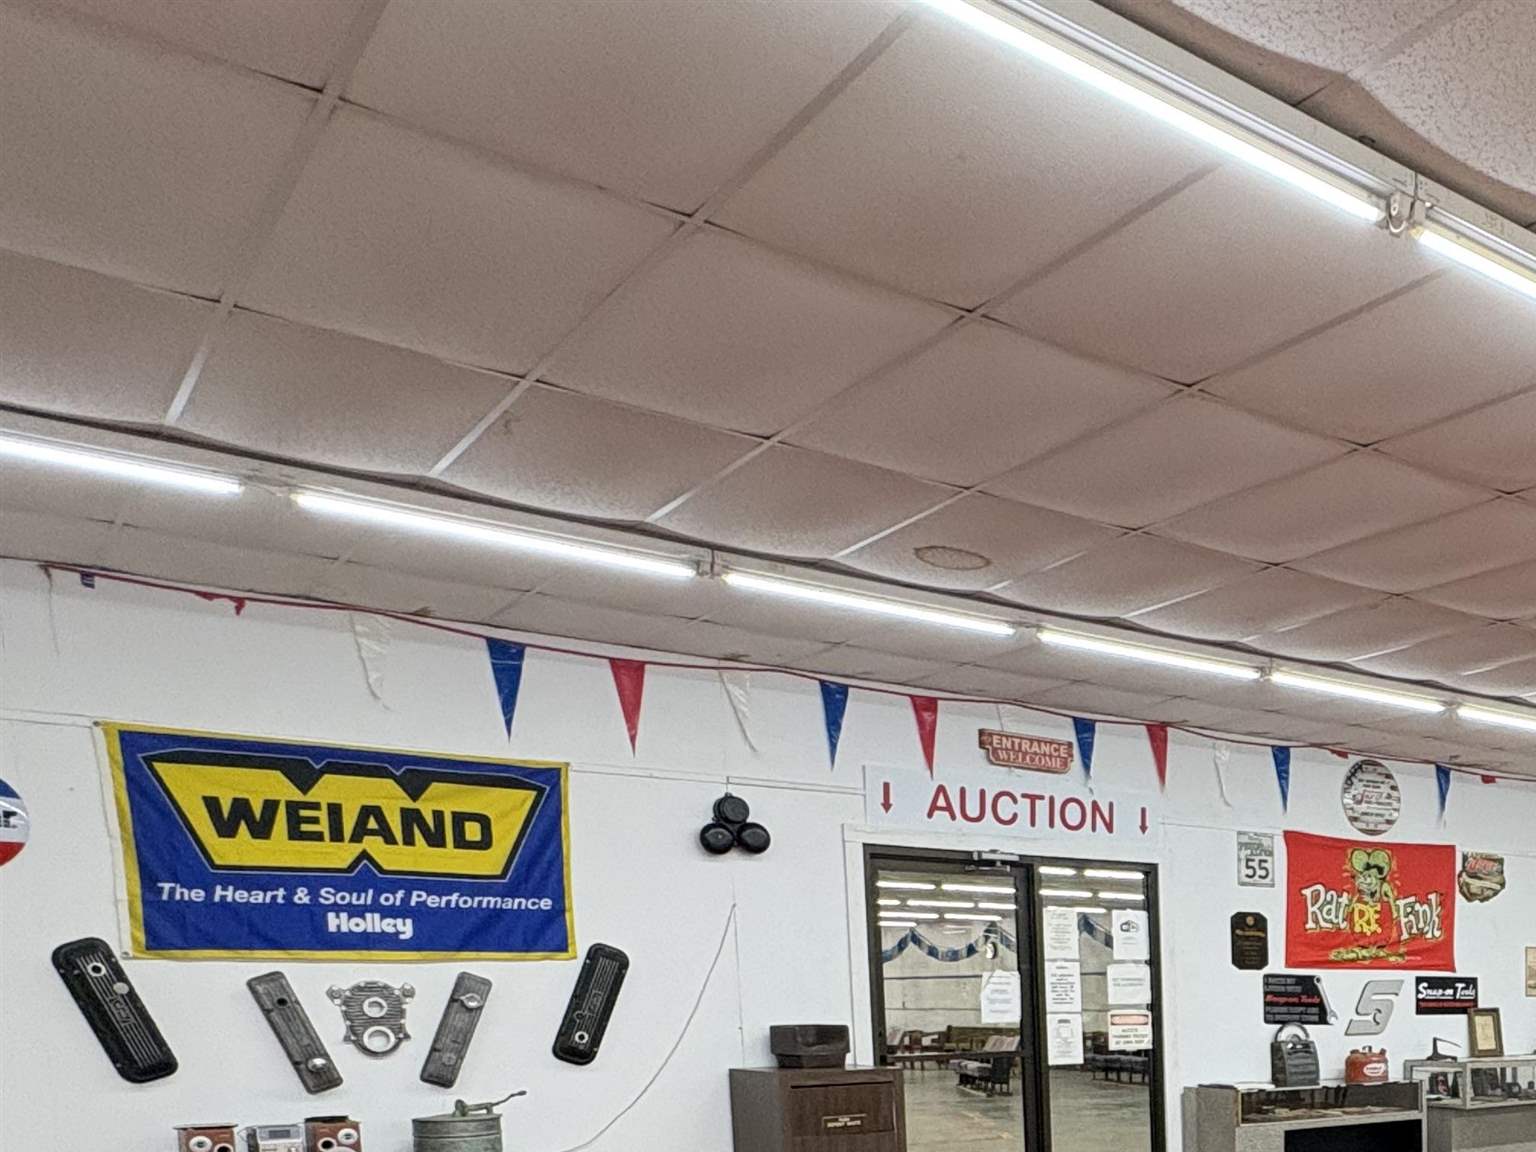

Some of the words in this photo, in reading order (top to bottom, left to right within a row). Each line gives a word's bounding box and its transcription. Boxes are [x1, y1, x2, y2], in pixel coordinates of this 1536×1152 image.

[992, 735, 1069, 757] ENTRANCE
[997, 749, 1065, 769] WELCOME
[202, 795, 493, 851] WEIAND
[927, 784, 1114, 834] AUCTION
[1244, 858, 1270, 879] 55
[157, 882, 206, 903] The
[213, 884, 286, 904] Heart
[294, 887, 311, 904] &
[319, 887, 373, 906] Soul
[379, 888, 405, 906] of
[410, 889, 553, 911] Performance
[1301, 884, 1350, 930] Rat
[327, 911, 414, 940] Holley
[1397, 891, 1443, 941] Fink
